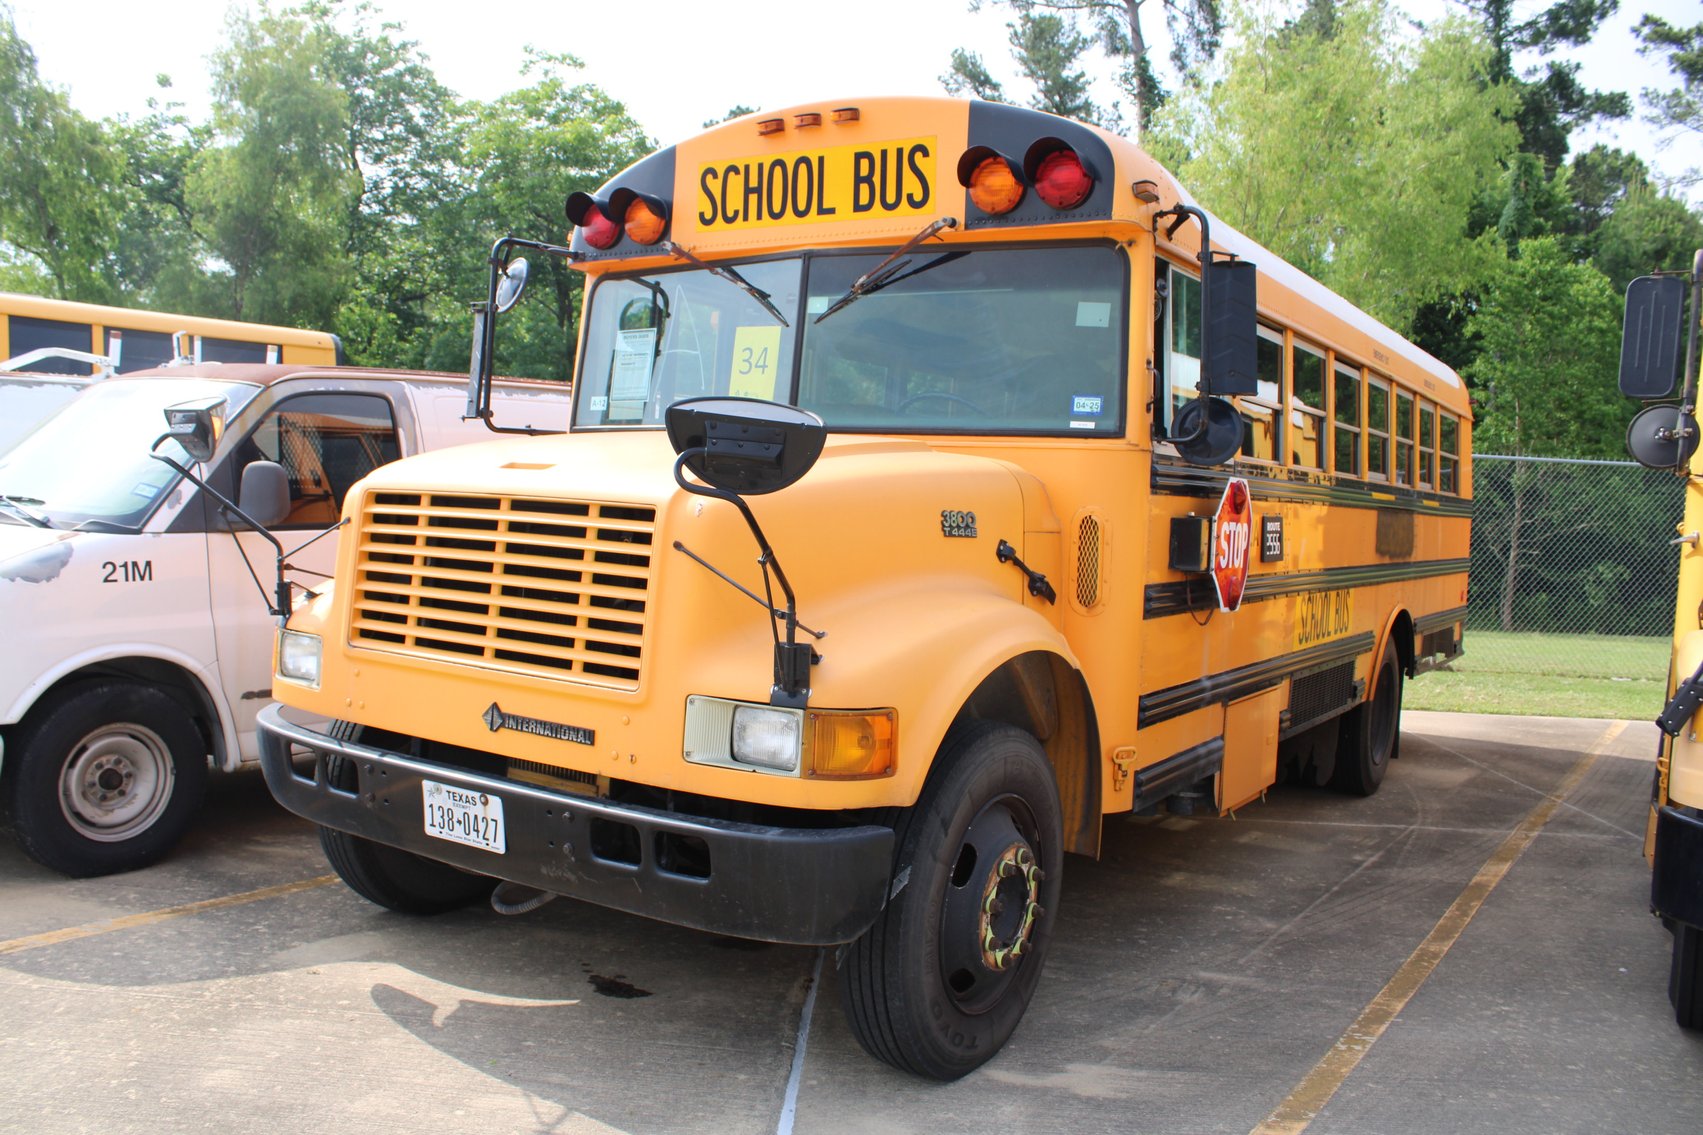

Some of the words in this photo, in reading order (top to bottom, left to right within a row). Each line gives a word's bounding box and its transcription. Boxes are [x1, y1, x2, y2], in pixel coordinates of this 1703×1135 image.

[699, 155, 836, 226] SCHOOL
[853, 144, 930, 213] BUS
[738, 346, 769, 375] 34
[942, 511, 977, 527] 3800
[1266, 522, 1281, 531] ROUTE
[1220, 521, 1249, 569] STOP
[102, 560, 152, 583] 21M
[1298, 591, 1332, 645] SCHOOL
[1333, 588, 1351, 635] BUS
[504, 714, 592, 745] INTERNATIONAL
[446, 790, 477, 806] TEXAS
